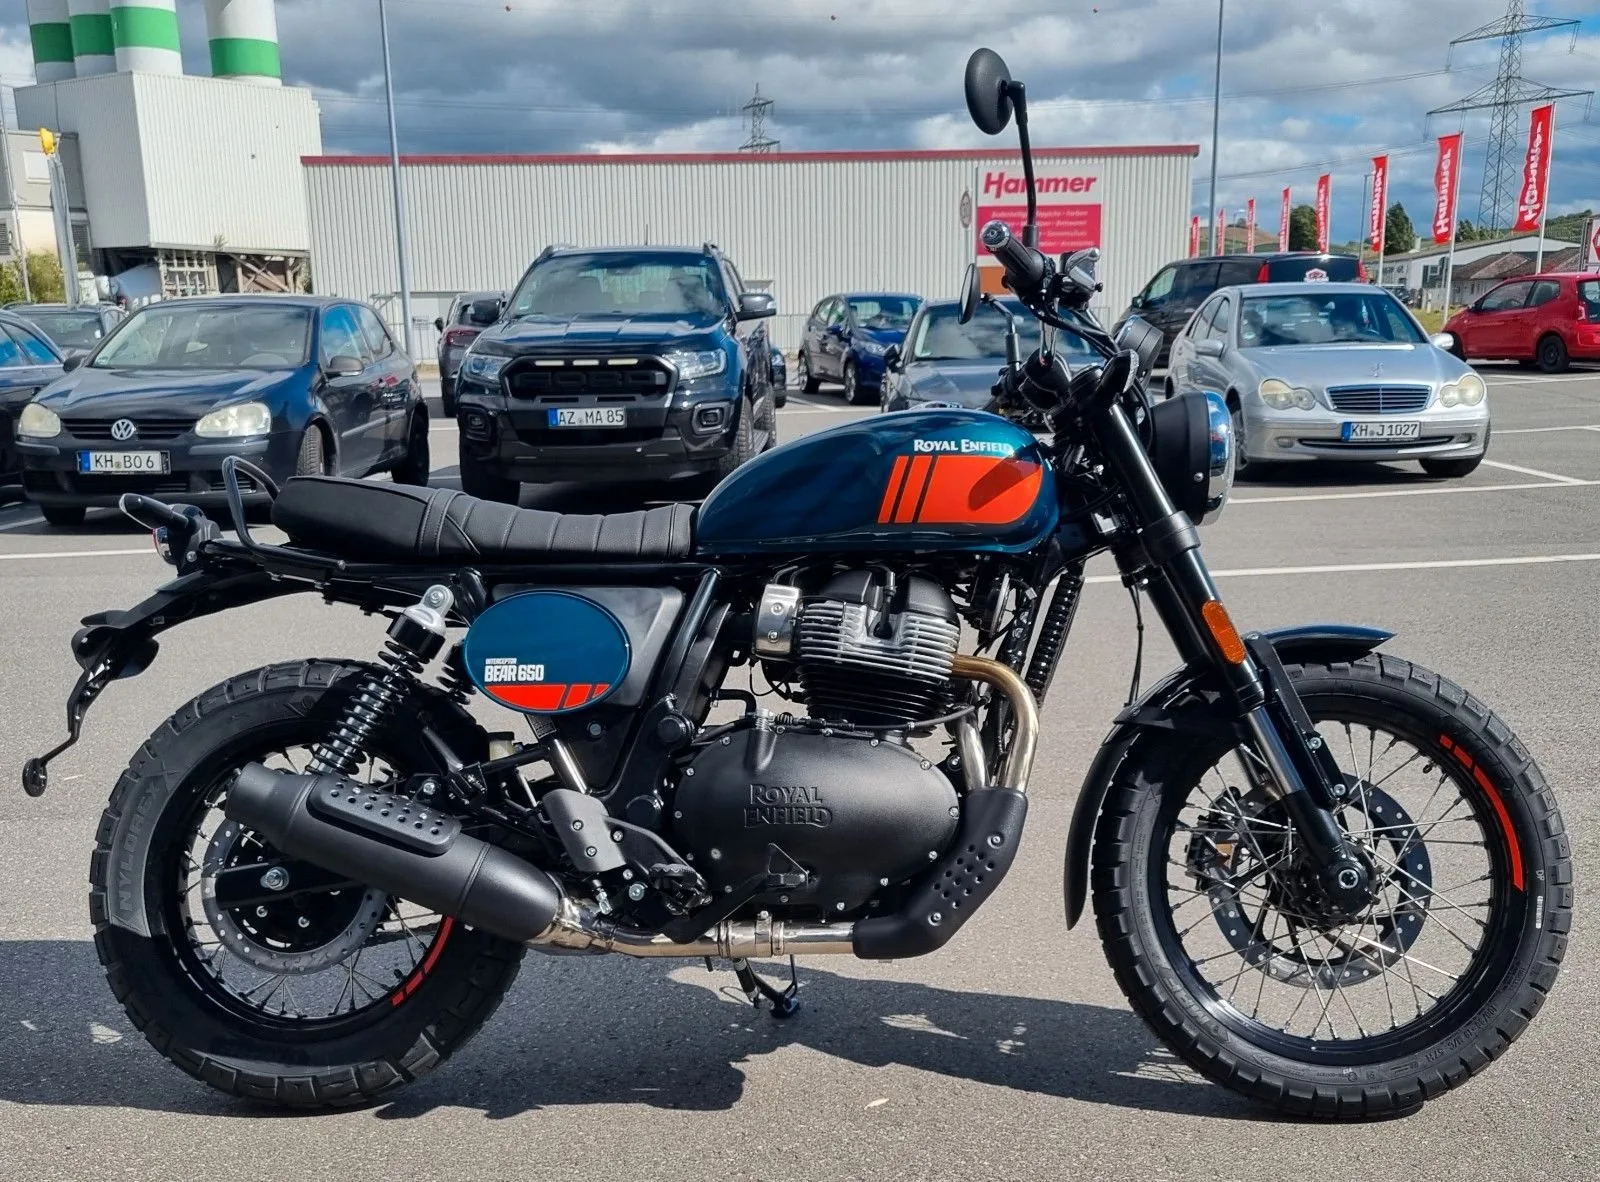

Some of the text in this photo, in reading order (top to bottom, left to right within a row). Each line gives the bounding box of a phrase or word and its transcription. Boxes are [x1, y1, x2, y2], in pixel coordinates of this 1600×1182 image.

[559, 409, 624, 425] AZ MA 85
[1352, 423, 1418, 437] KH J 1027
[913, 439, 959, 452] ROYAL
[94, 454, 113, 469] KH
[484, 664, 544, 682] BEAR 650
[750, 784, 823, 806] ROYAL
[743, 806, 833, 829] ENFIELD
[1162, 978, 1211, 1025] MRF
